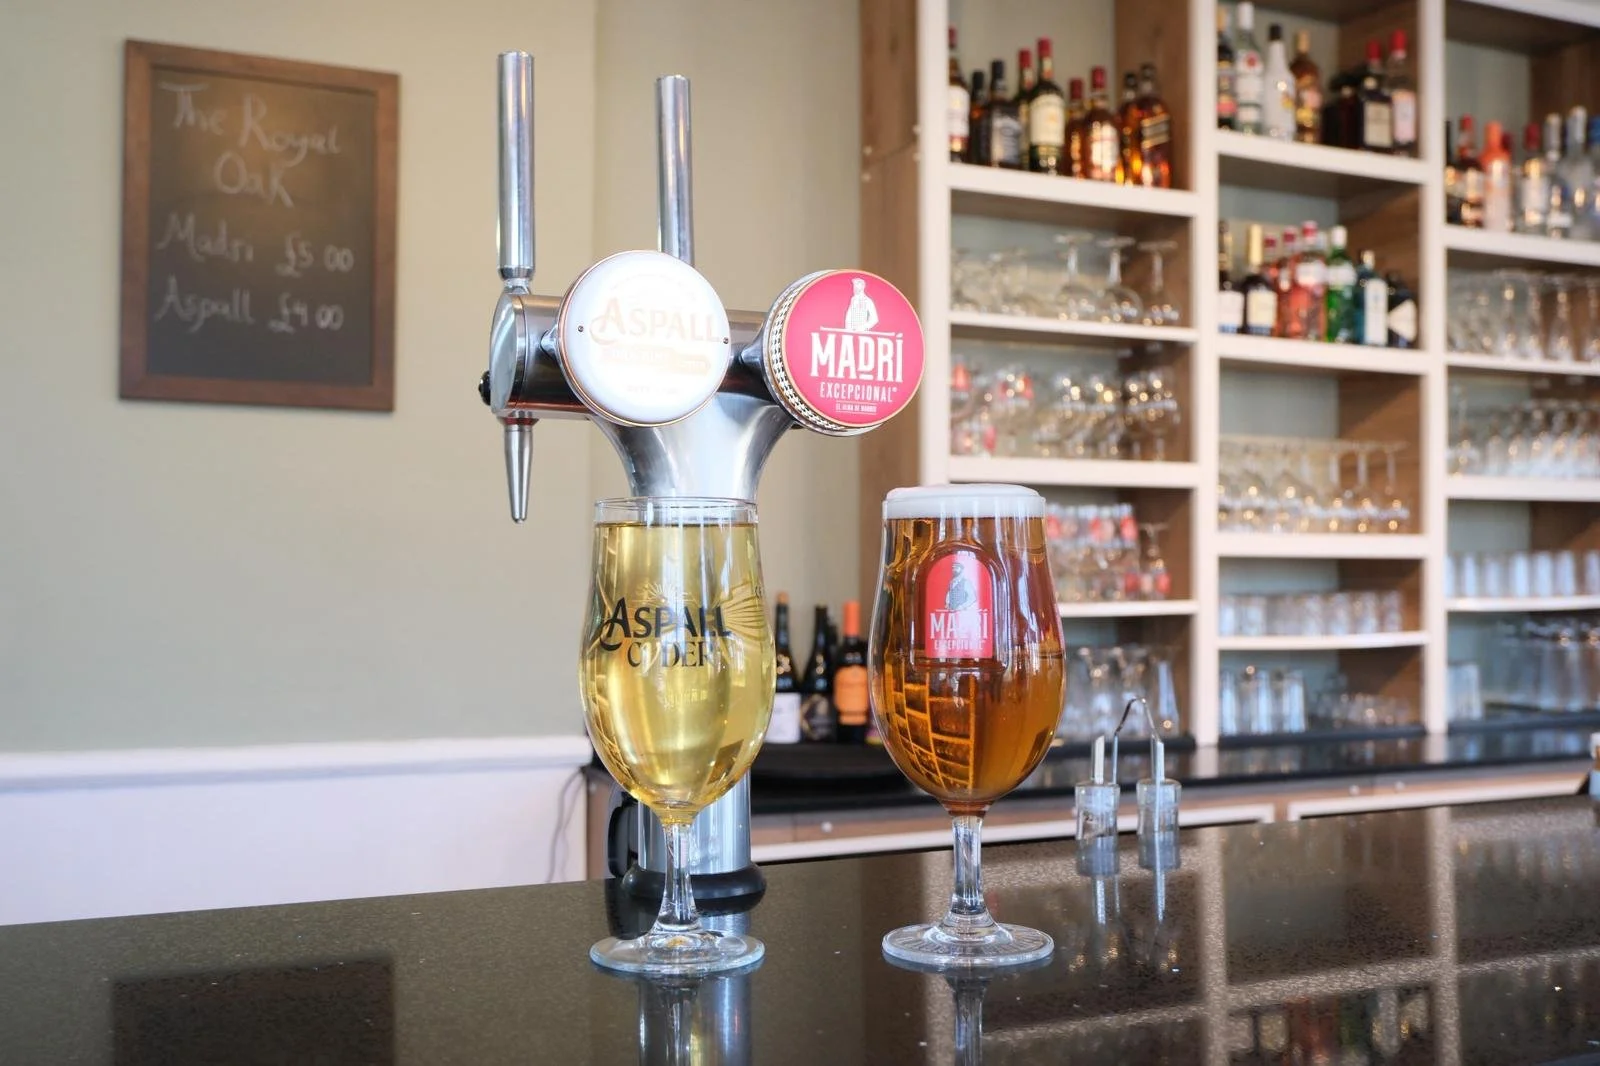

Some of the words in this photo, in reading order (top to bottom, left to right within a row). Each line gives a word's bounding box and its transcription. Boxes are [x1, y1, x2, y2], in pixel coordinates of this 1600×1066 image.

[238, 94, 341, 168] Royal
[153, 274, 256, 333] Aspall
[810, 332, 904, 383] MADRÍ
